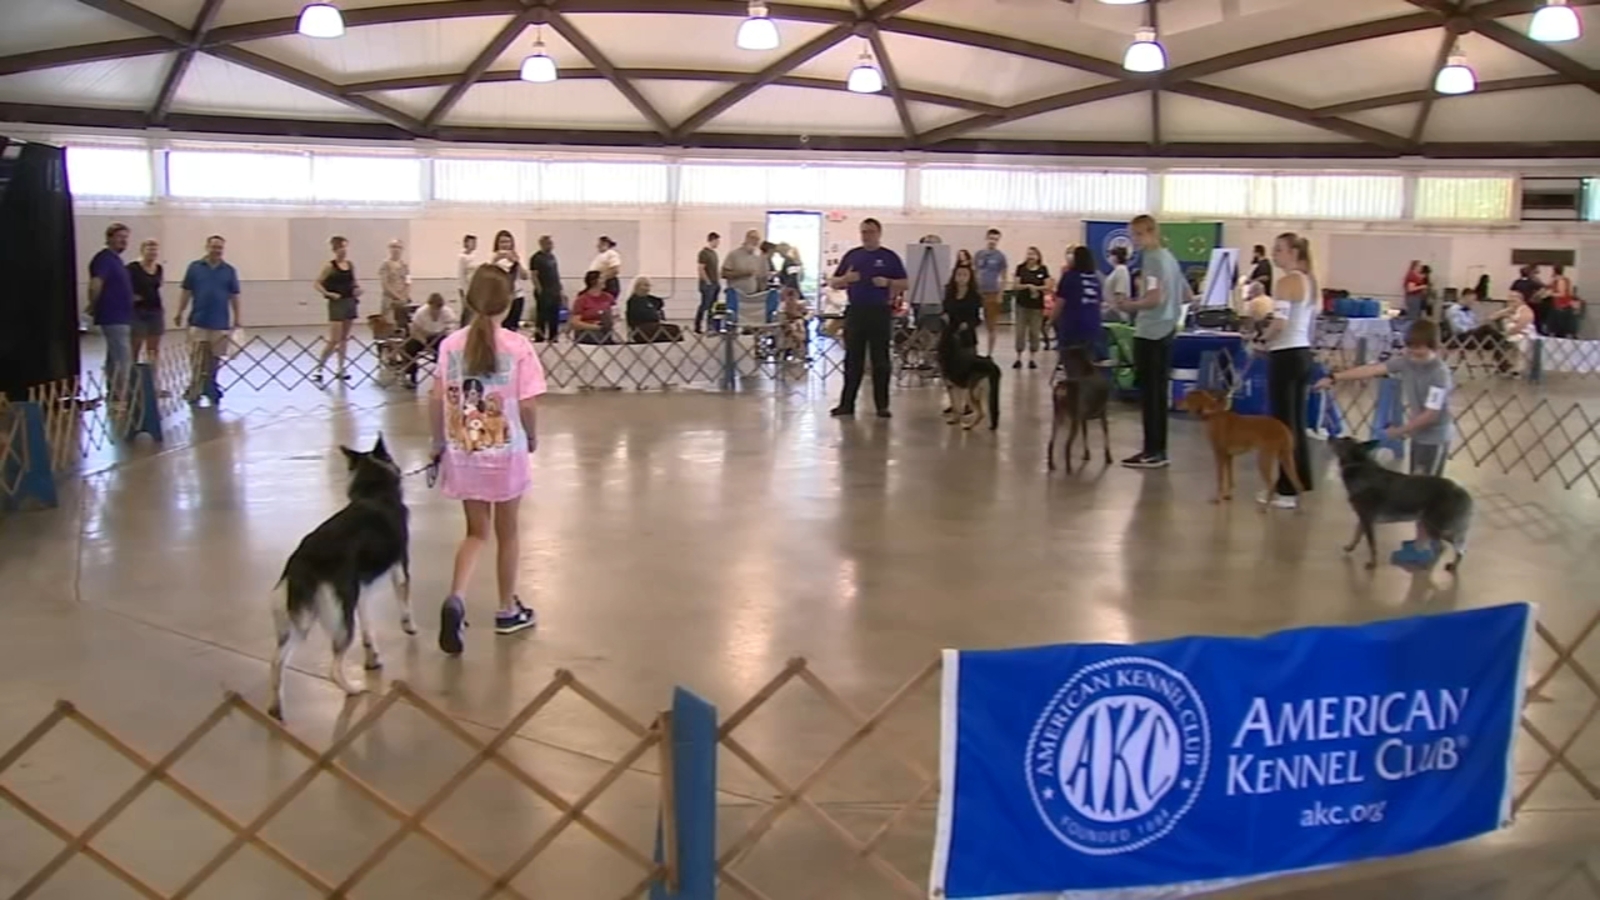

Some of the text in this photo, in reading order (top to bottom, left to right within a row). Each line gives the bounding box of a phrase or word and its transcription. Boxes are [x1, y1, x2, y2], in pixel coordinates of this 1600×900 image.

[1037, 670, 1201, 776] AMERICAN KENNEL CLUB
[1231, 688, 1469, 748] AMERICAN
[1065, 703, 1170, 817] AKC
[1226, 750, 1365, 796] KENNEL
[1300, 801, 1387, 827] akc.org
